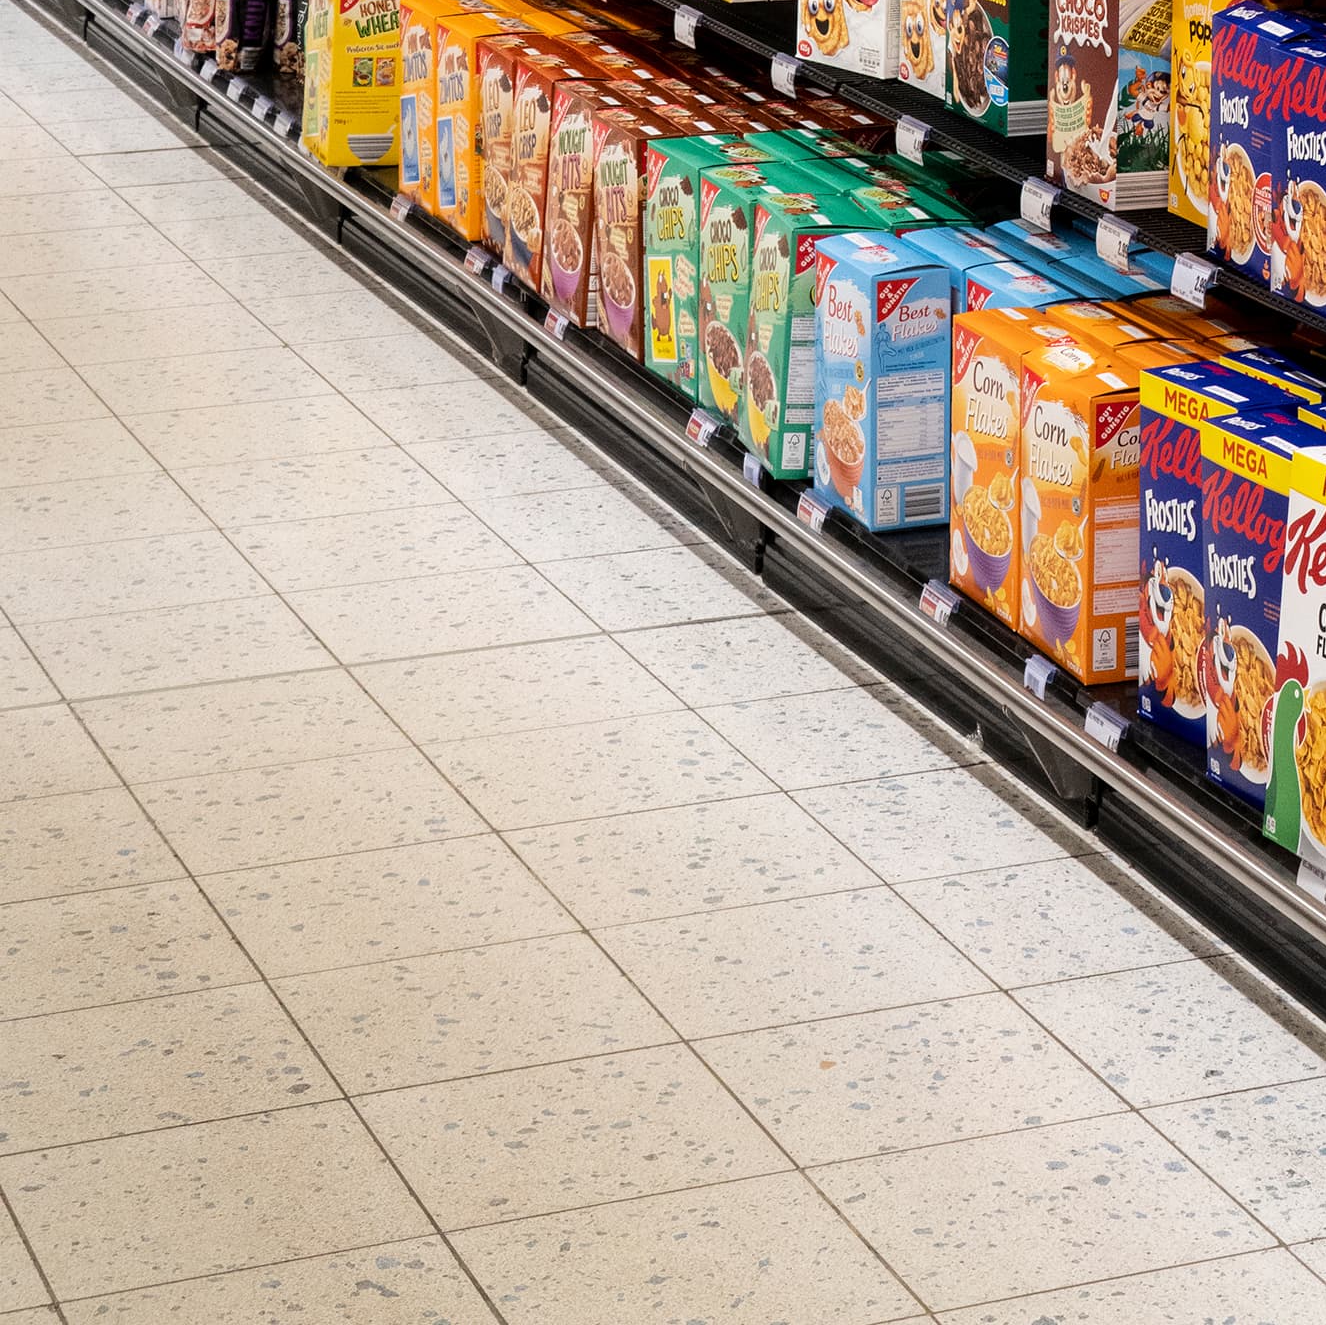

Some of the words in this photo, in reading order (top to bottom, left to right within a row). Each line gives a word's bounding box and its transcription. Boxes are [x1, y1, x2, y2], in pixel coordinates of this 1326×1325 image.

[1061, 12, 1101, 39] KRISPIES
[519, 97, 536, 130] LEO
[1220, 91, 1249, 129] FROSTIES
[657, 206, 686, 240] CHIPS
[710, 217, 732, 244] CHOCO
[707, 243, 739, 284] CHIPS
[828, 285, 853, 323] Best
[899, 304, 931, 322] Best
[823, 321, 859, 359] Flakes
[973, 361, 1004, 401] Corn
[965, 401, 1007, 439] Flakes
[1164, 387, 1210, 421] MEGA
[1034, 405, 1068, 448] Corn
[1028, 445, 1073, 487] Flakes
[1145, 489, 1196, 542] FROSTIES
[1207, 543, 1256, 600] FROSTIES
